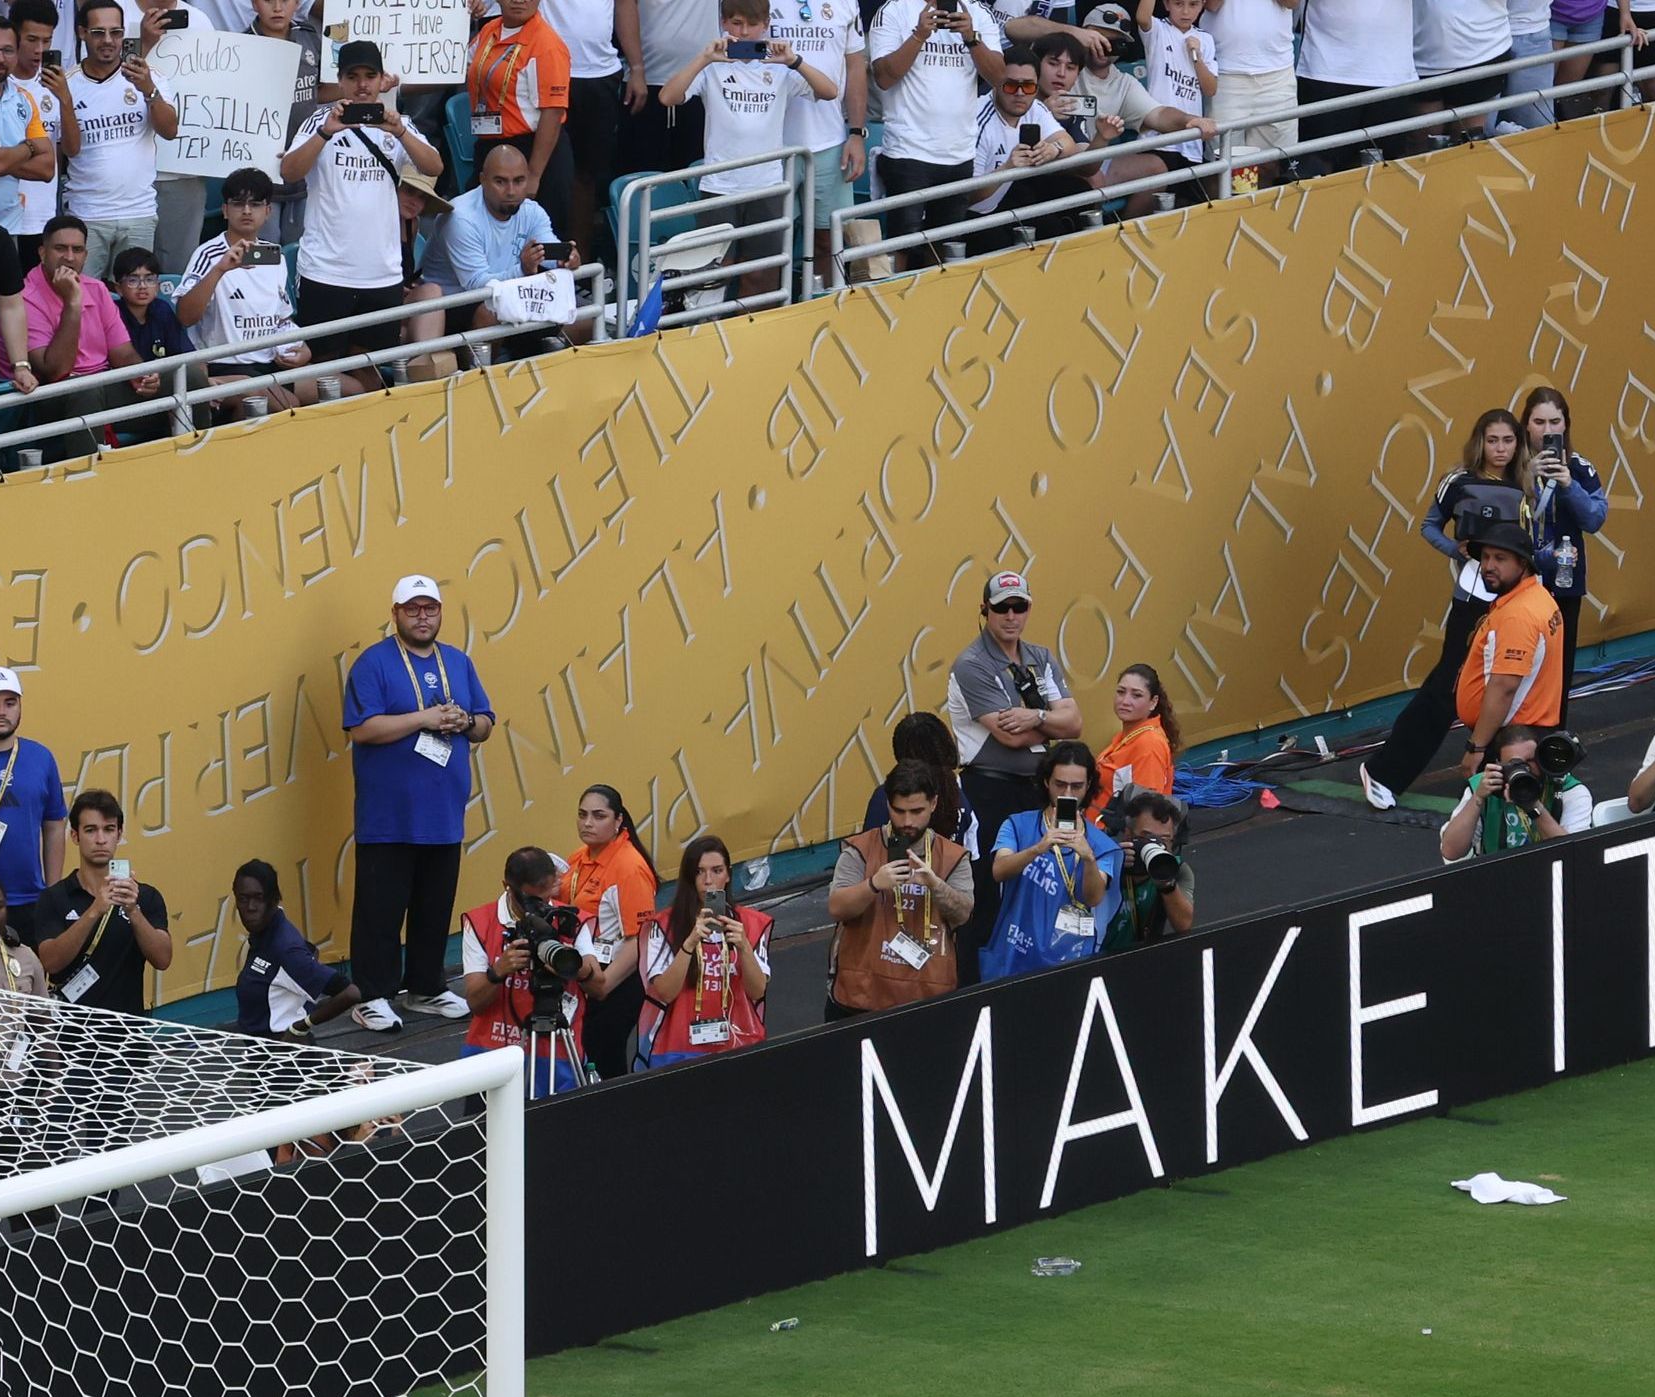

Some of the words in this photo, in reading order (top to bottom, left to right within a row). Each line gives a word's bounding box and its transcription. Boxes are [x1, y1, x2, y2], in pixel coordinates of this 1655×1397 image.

[353, 14, 381, 36] can
[389, 13, 402, 35] I
[412, 13, 443, 35] Have
[770, 24, 834, 39] Emirates
[155, 35, 241, 80] Saludos
[401, 38, 470, 75] JERSEY
[723, 87, 776, 102] Emirates
[87, 131, 101, 144] FLY
[104, 125, 135, 141] BETTER
[221, 140, 253, 162] AGS
[343, 169, 358, 181] FLY
[360, 169, 385, 181] BETTER
[1022, 862, 1059, 897] FILMS
[861, 891, 1441, 1259] MAKE
